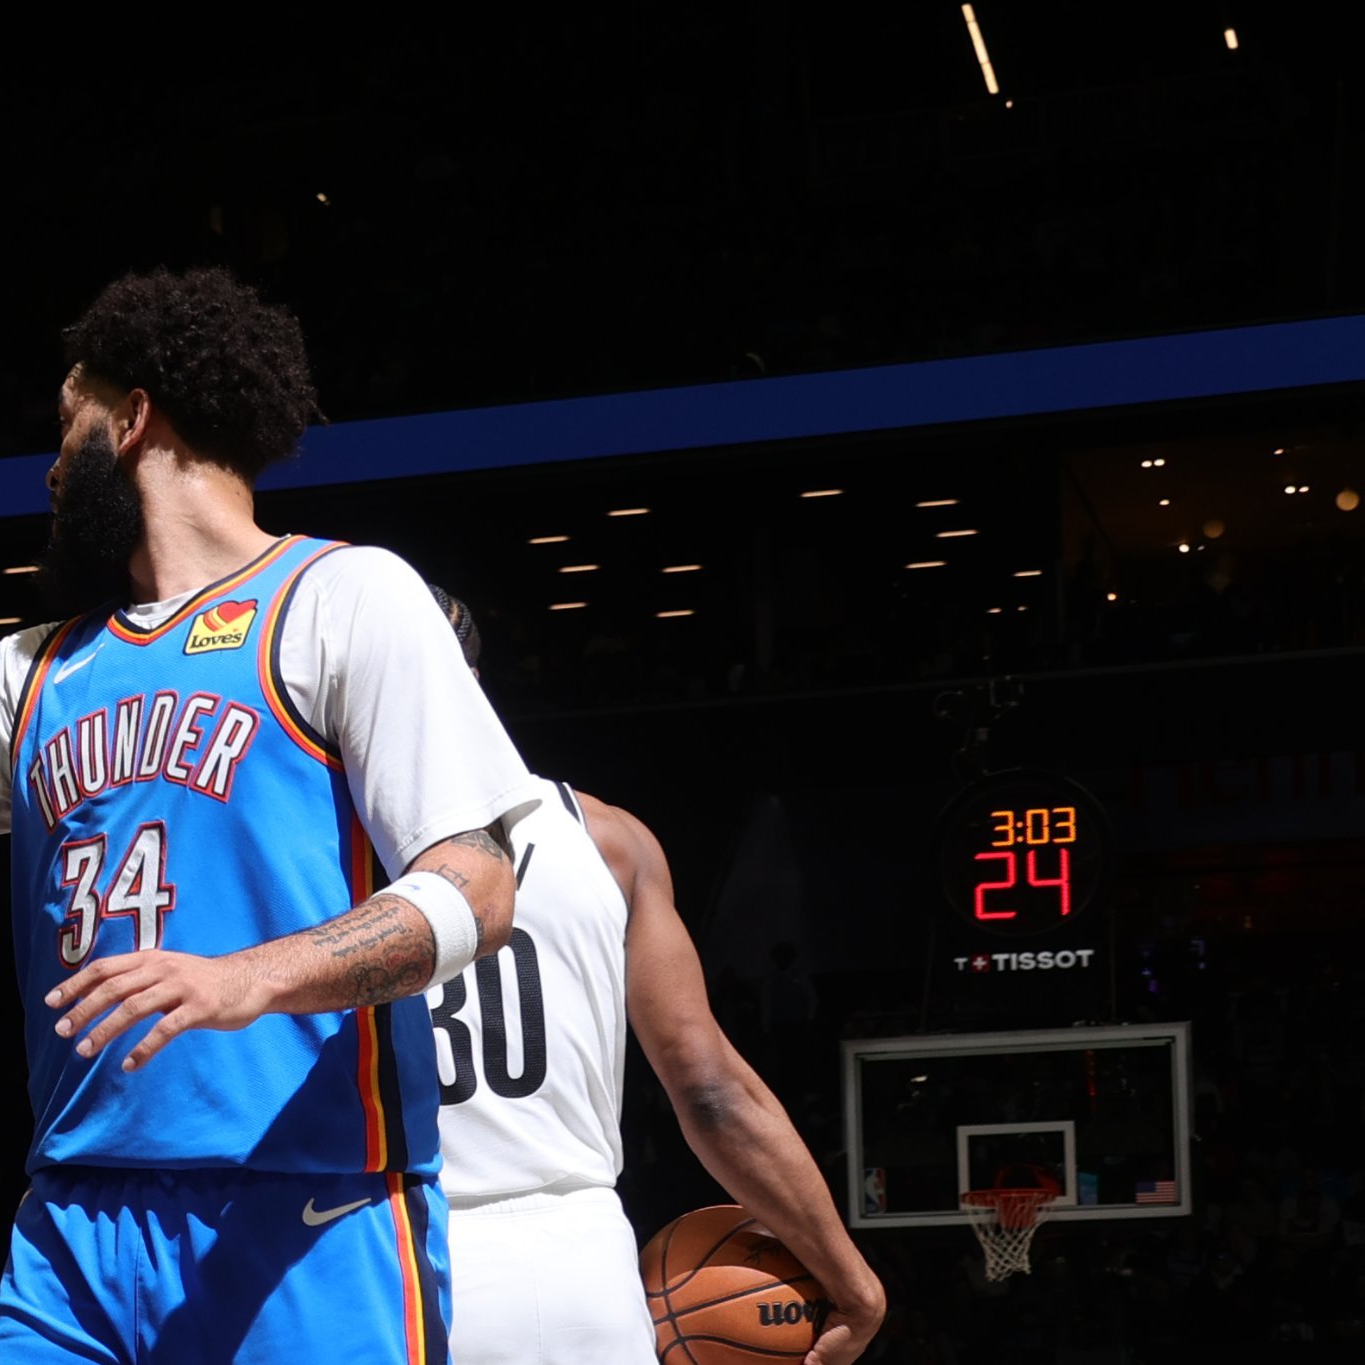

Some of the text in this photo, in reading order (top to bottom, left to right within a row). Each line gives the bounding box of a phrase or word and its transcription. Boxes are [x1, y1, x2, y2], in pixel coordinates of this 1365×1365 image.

[29, 690, 259, 834] THUNDER
[989, 805, 1077, 848] 3:03
[58, 820, 175, 969] 34
[972, 847, 1071, 921] 24
[991, 948, 1096, 973] TISSOT
